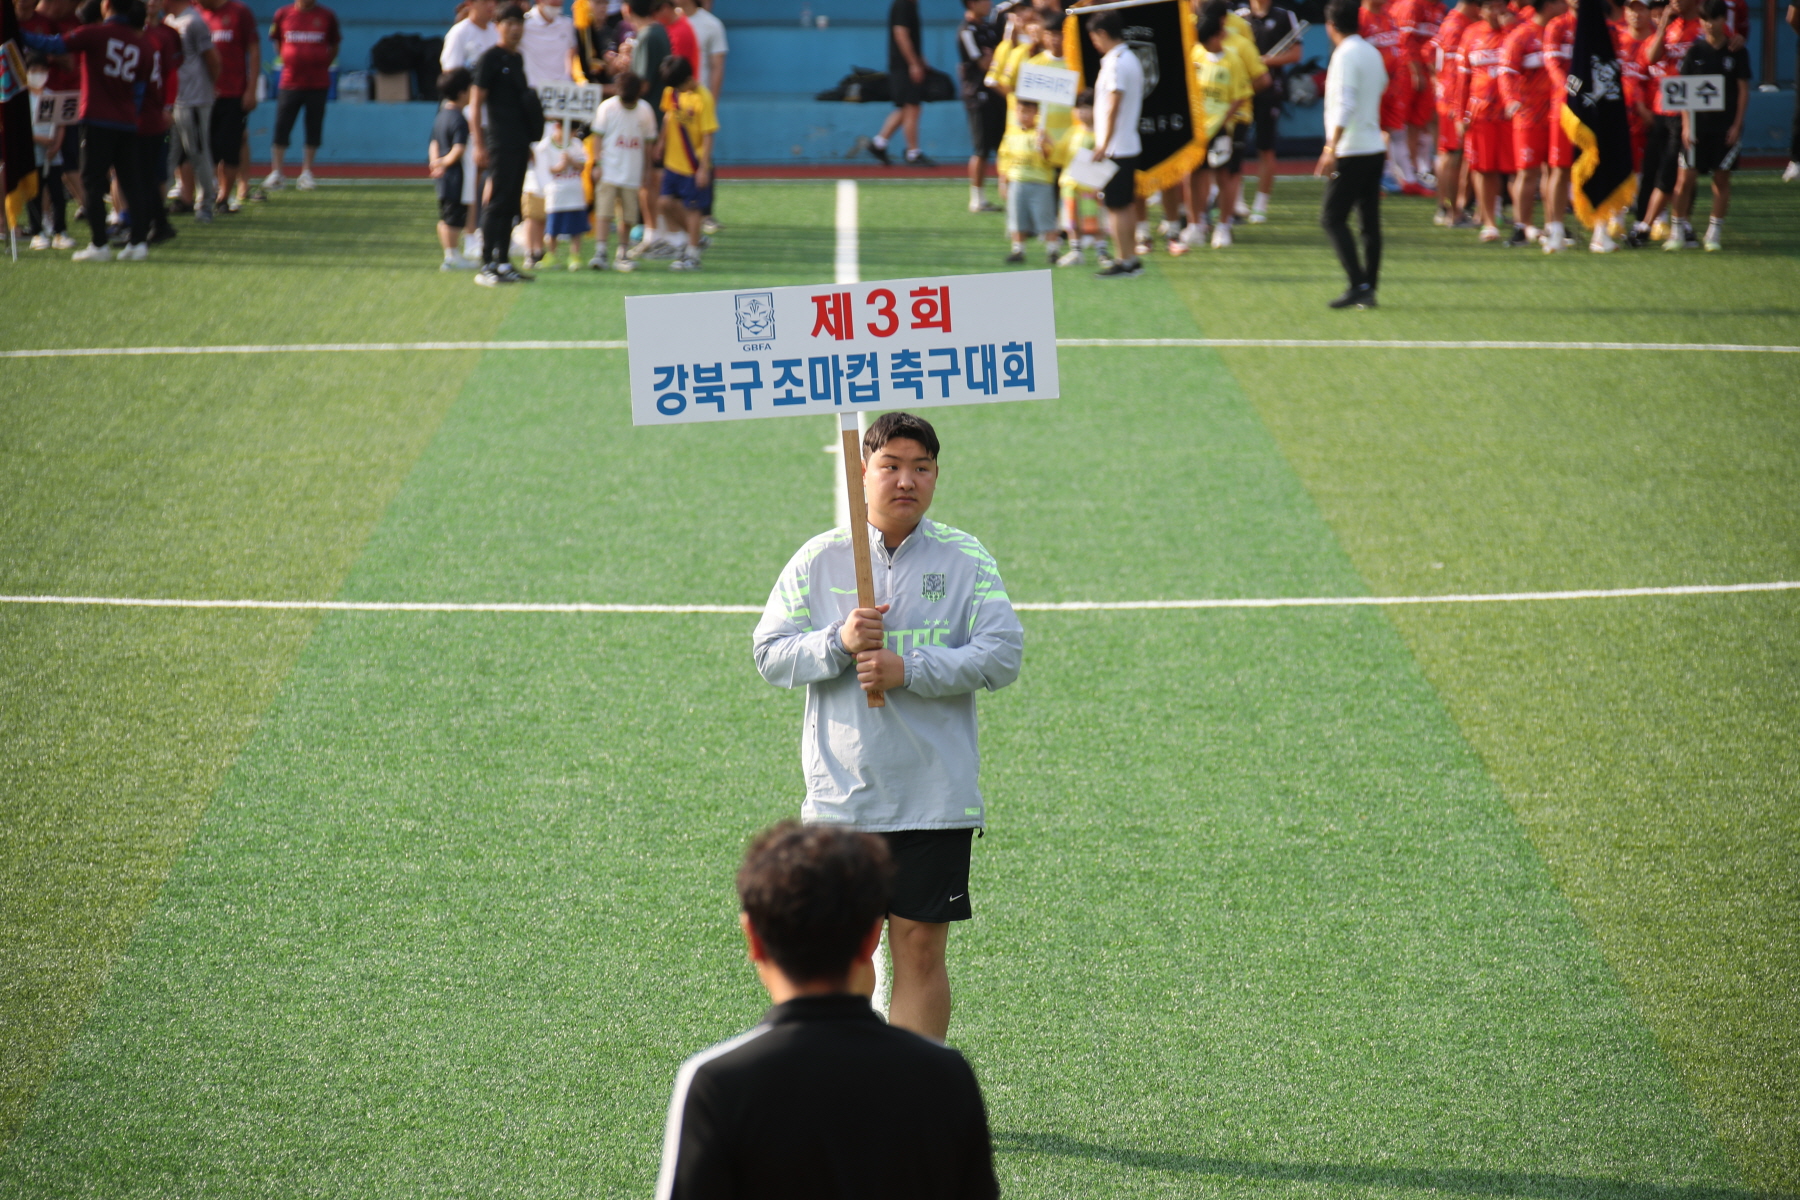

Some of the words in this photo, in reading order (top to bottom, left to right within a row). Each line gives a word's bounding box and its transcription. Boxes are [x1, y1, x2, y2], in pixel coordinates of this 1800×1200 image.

[103, 37, 140, 83] 52
[1665, 80, 1720, 105] 인수
[811, 286, 951, 340] 제3회
[742, 342, 772, 352] GBFA
[654, 361, 763, 416] 강북구
[772, 352, 880, 407] 조마컵
[891, 341, 1036, 400] 축구대회
